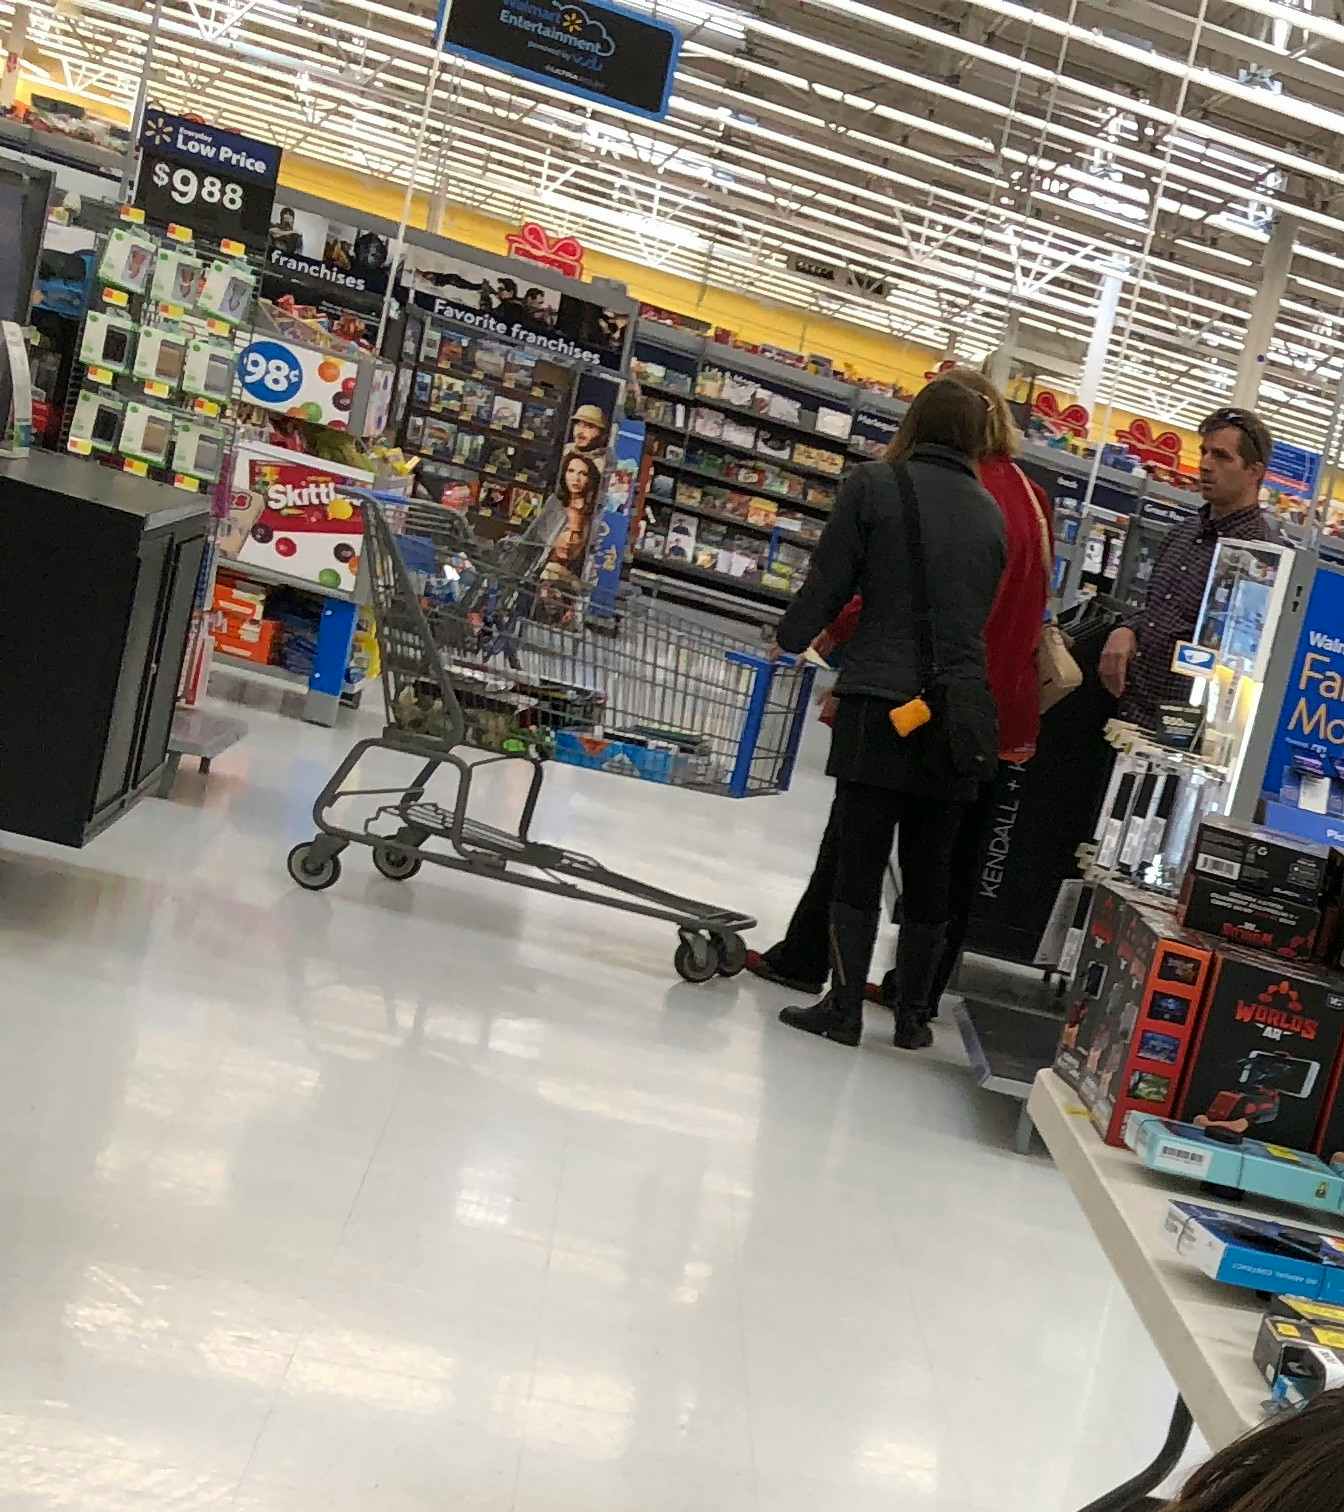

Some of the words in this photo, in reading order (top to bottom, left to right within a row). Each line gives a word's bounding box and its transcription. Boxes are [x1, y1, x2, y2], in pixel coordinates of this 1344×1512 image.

[500, 10, 602, 54] Entertainment
[177, 135, 217, 158] Low
[219, 146, 267, 174] Price
[270, 250, 366, 292] franchises
[433, 299, 506, 334] Favorite
[510, 322, 601, 366] franchises
[267, 481, 340, 511] Skittl
[979, 800, 1020, 899] KENDALL
[1234, 999, 1320, 1041] WORLDS
[1261, 1025, 1284, 1041] AR
